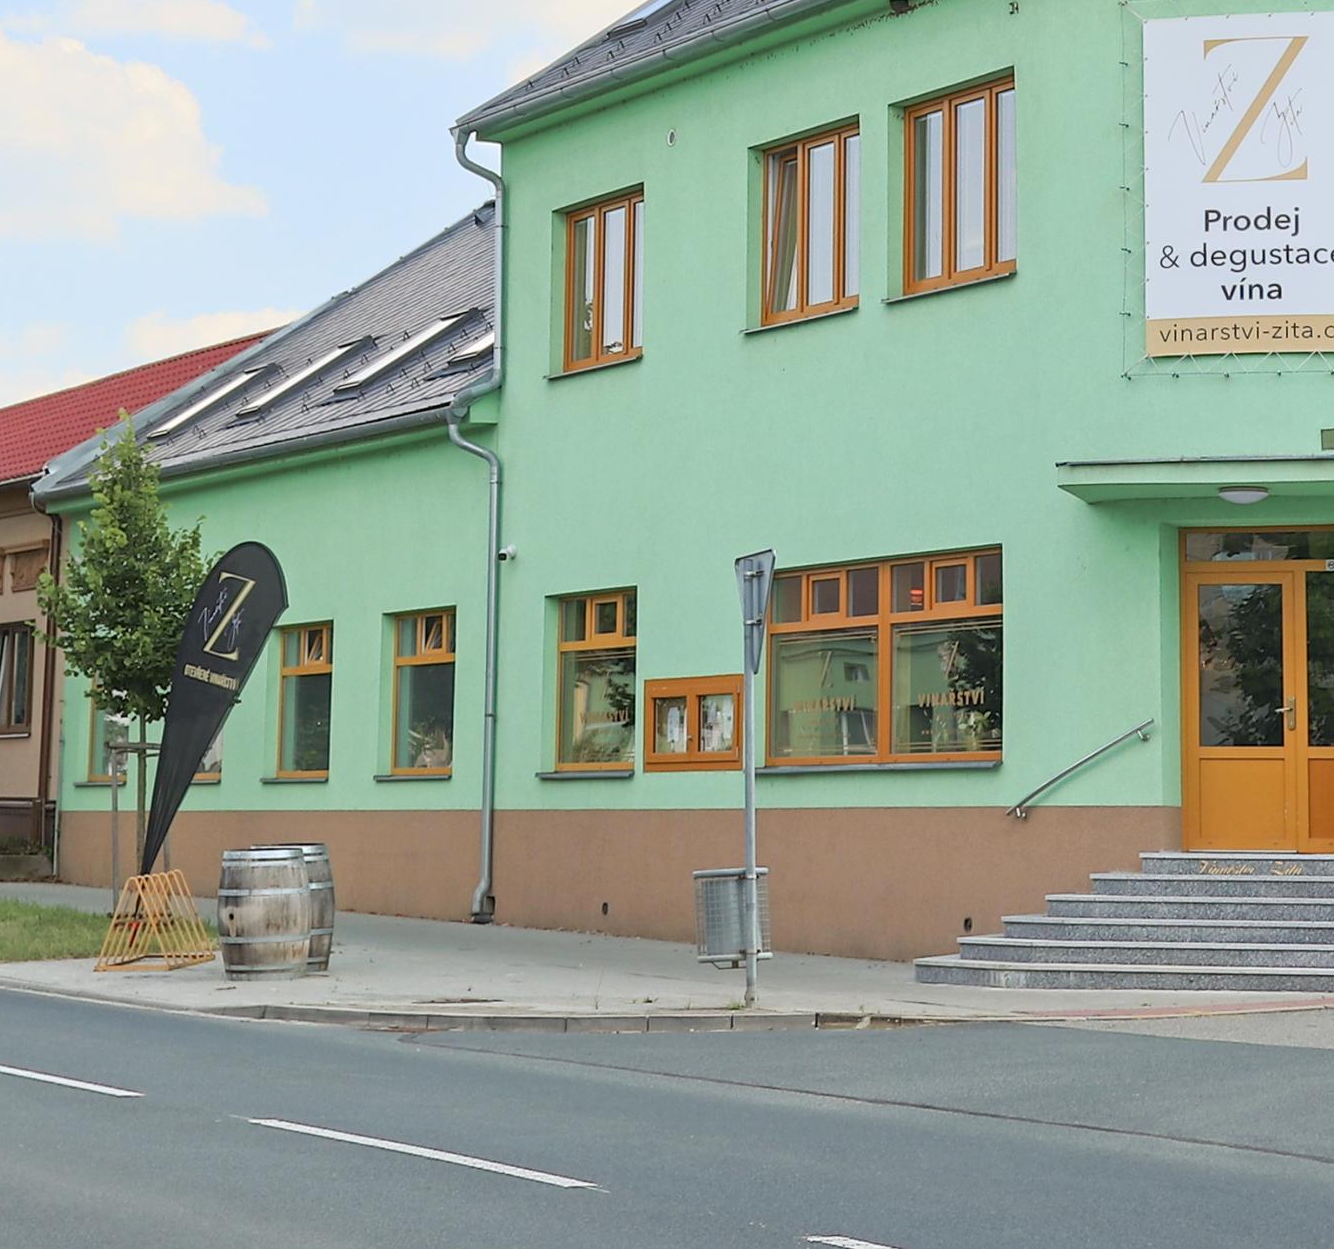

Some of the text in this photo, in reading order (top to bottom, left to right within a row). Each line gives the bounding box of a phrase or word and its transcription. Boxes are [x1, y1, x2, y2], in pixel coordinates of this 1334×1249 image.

[1204, 206, 1300, 237] Prodej
[1160, 245, 1180, 269] &
[1221, 277, 1283, 300] vína
